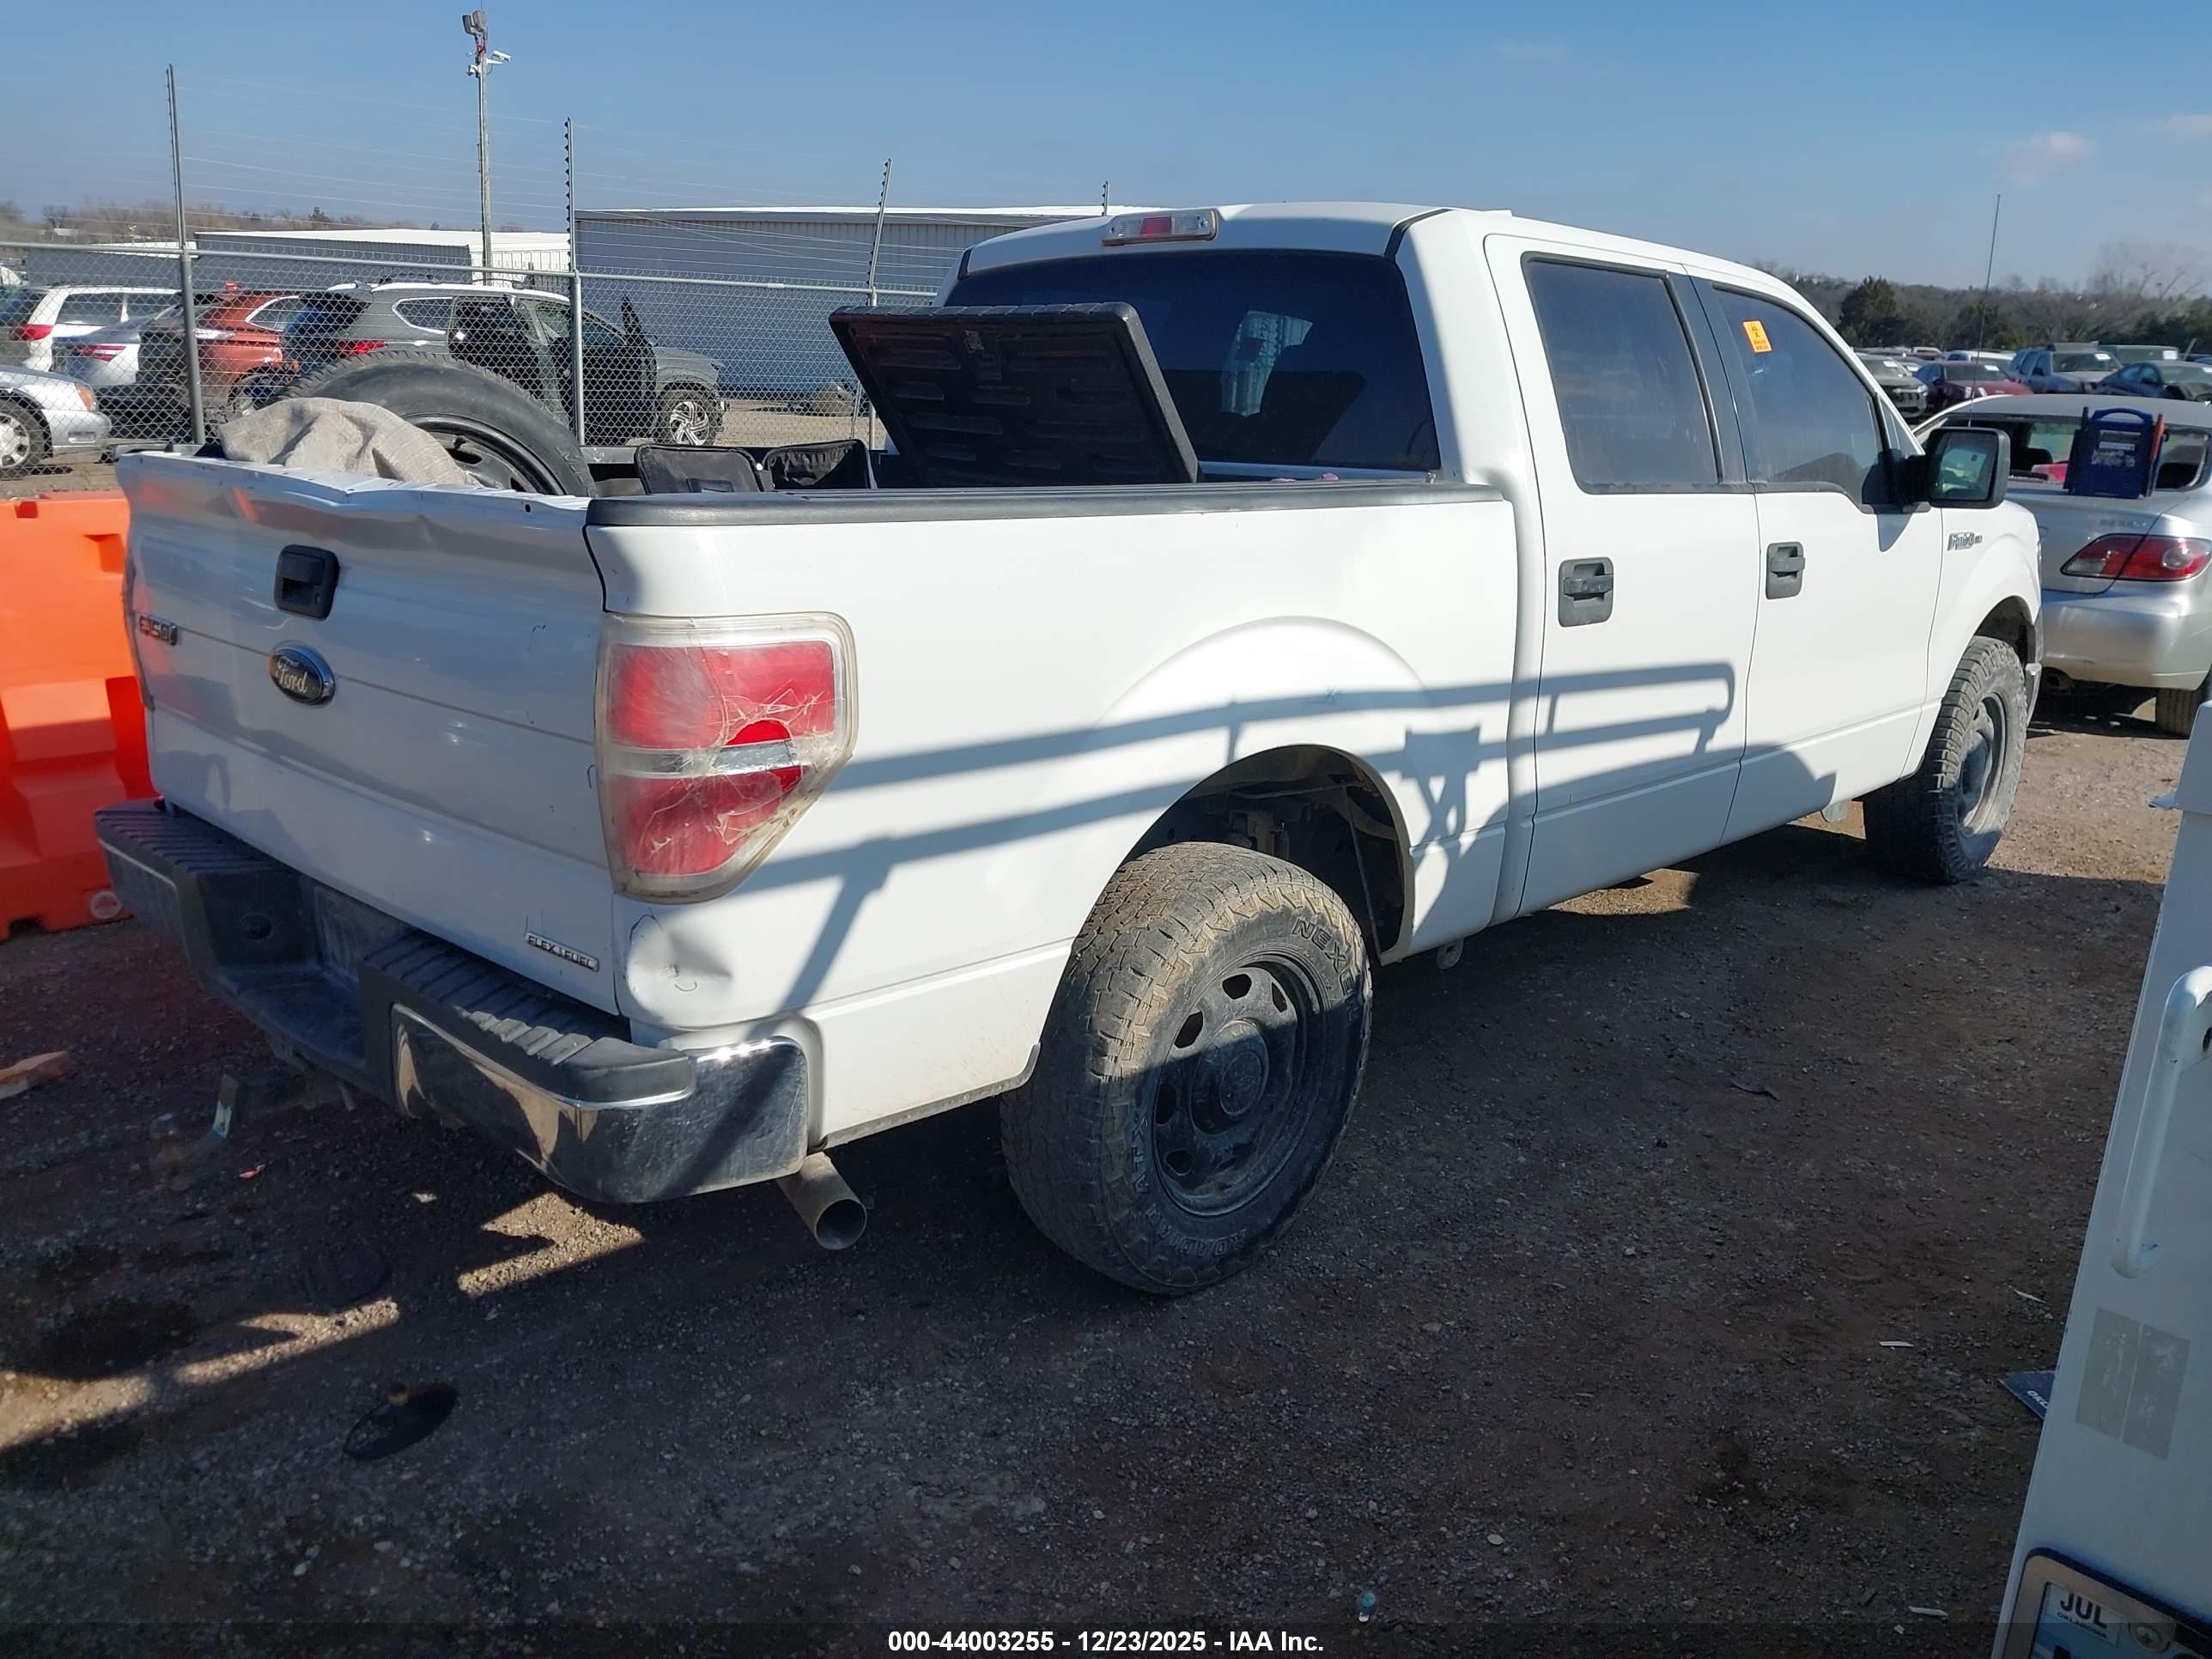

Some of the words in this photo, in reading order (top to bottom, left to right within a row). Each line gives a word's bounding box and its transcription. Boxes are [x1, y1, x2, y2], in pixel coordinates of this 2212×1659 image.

[276, 655, 310, 694] Ford
[527, 935, 556, 953] FLEX
[563, 950, 596, 971] FUEL
[2057, 1611, 2107, 1639] OKLAHOMA
[2060, 1592, 2107, 1630] JUL
